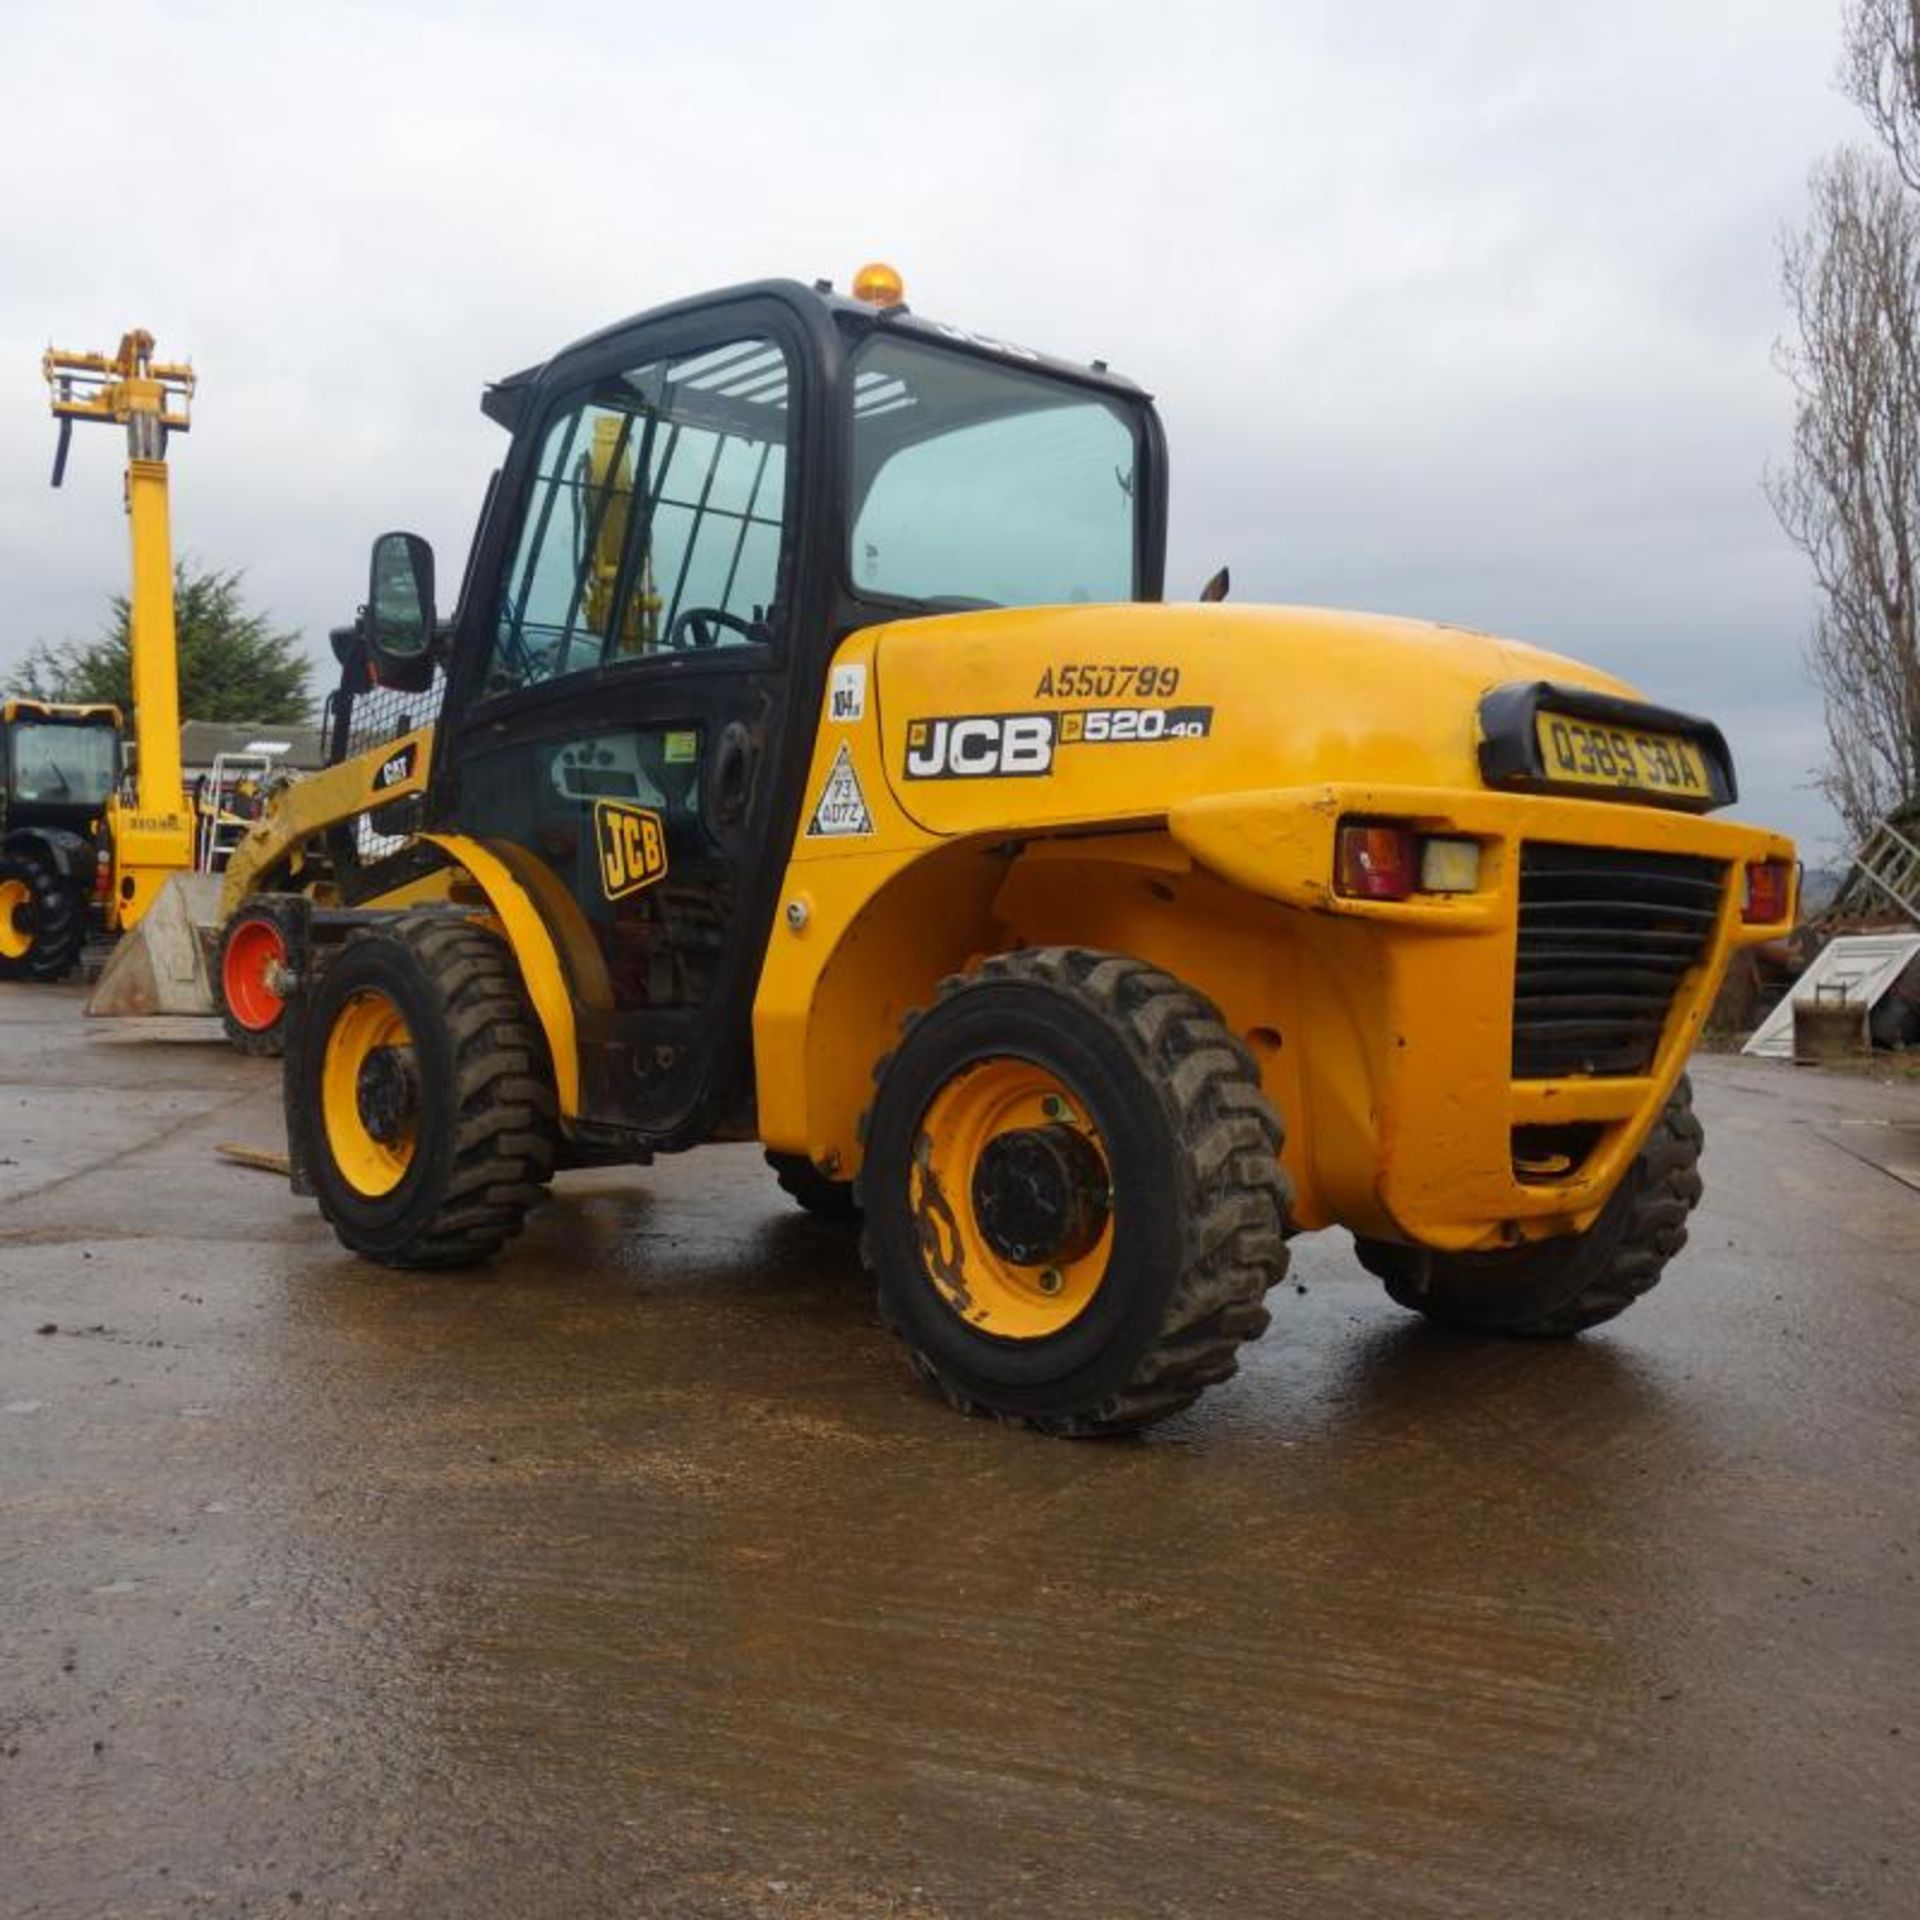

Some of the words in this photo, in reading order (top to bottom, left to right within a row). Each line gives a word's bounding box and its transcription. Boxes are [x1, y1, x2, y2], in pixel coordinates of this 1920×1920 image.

[383, 755, 407, 785] CAT
[908, 716, 1052, 776] JCB
[1084, 708, 1204, 741] 520-40
[606, 810, 661, 888] JCB
